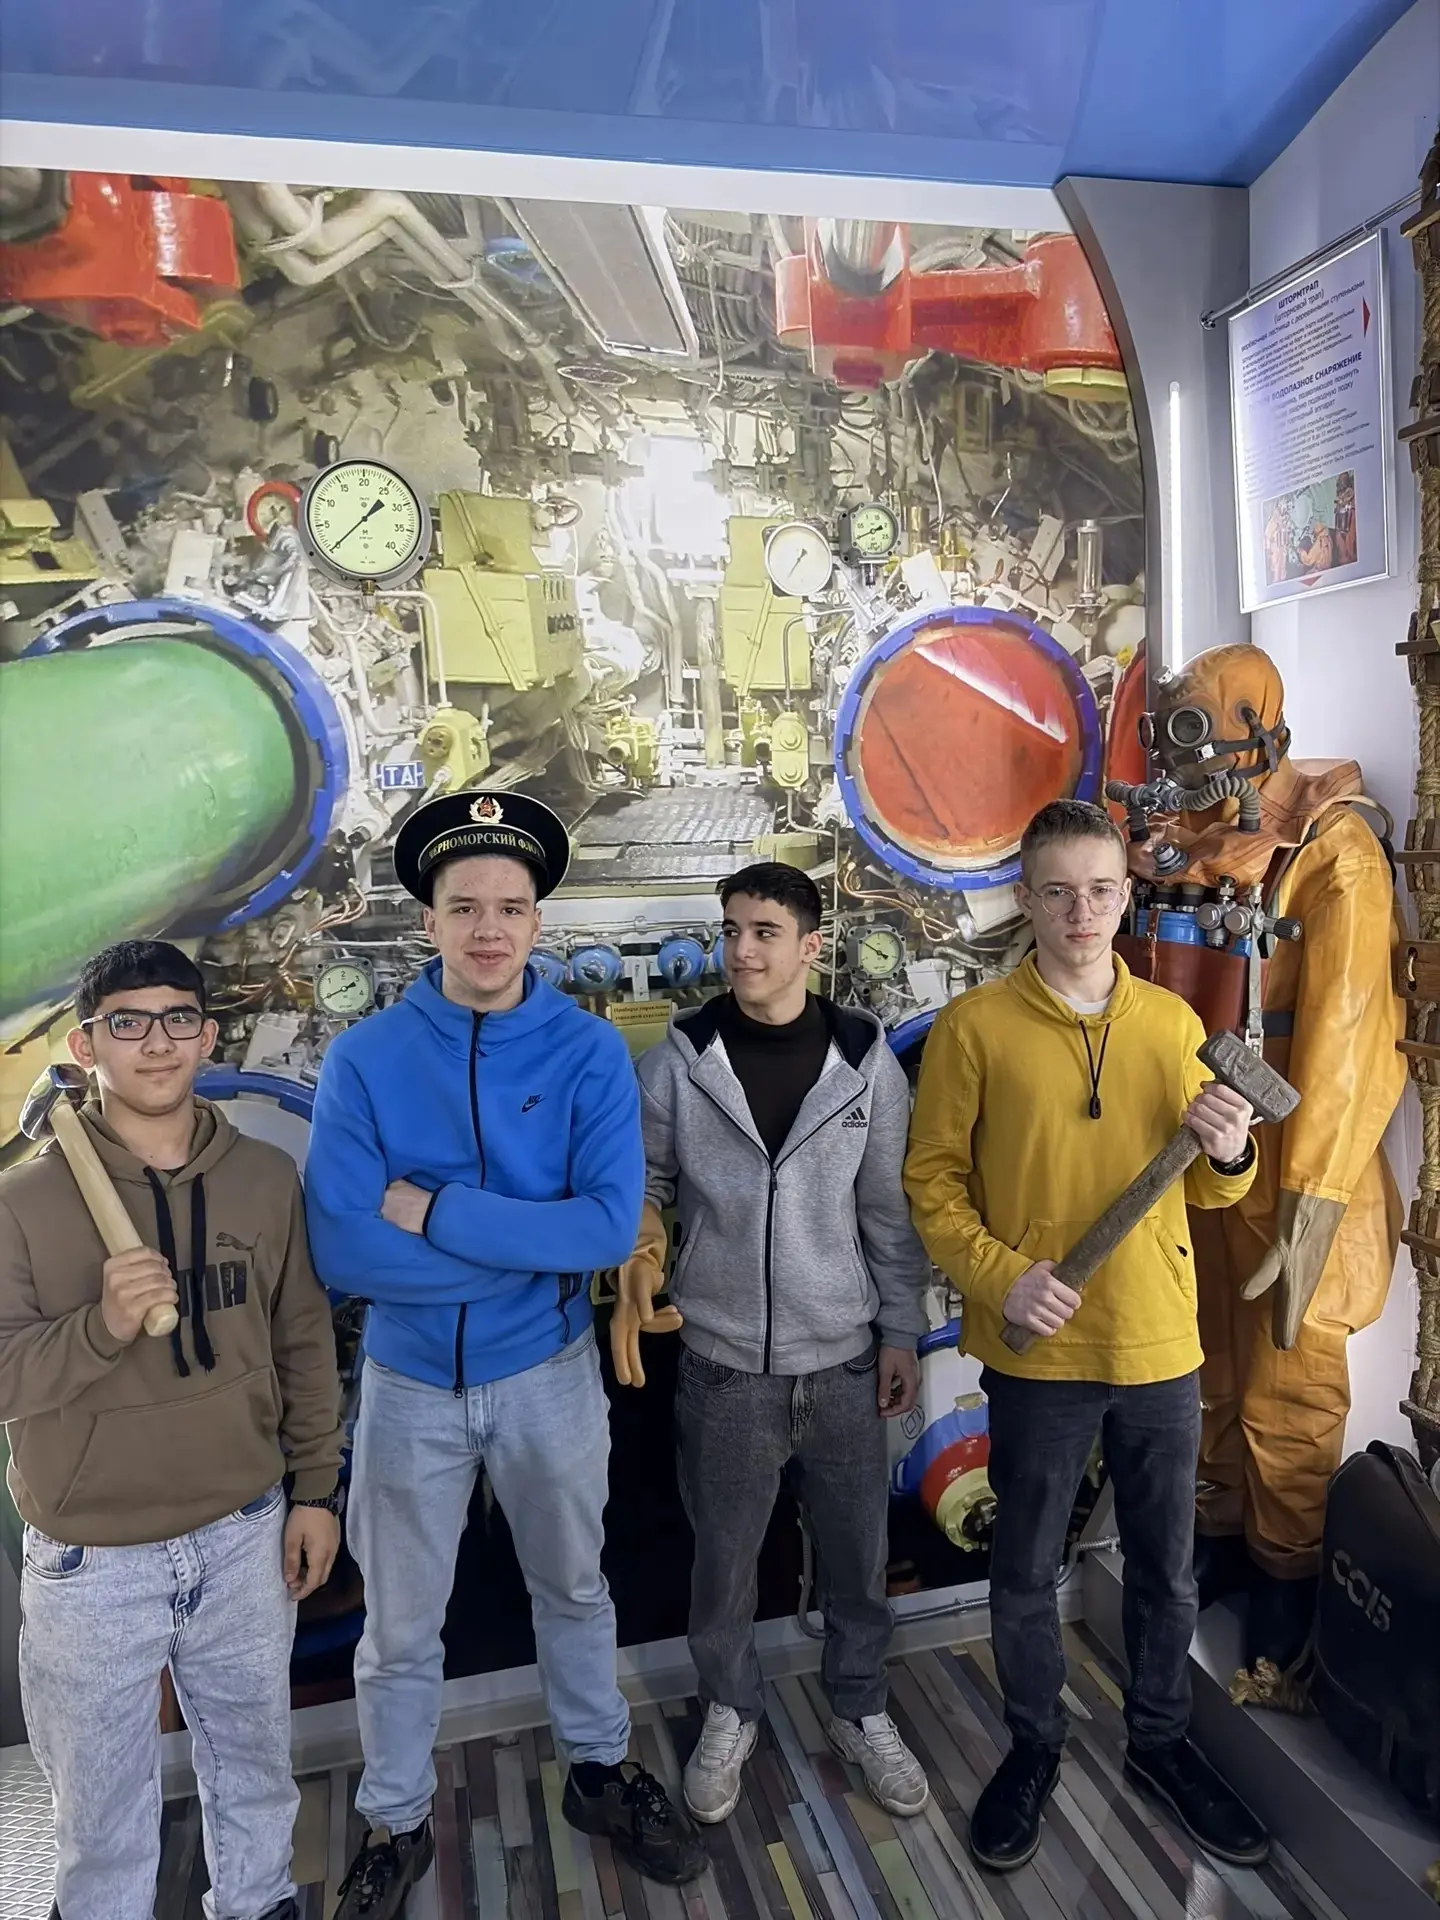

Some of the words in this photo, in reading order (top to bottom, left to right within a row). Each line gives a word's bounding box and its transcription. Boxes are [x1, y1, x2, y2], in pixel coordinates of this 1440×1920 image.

[1278, 279, 1318, 309] ШТОРМТРАП
[1308, 287, 1324, 305] трап)
[1314, 350, 1362, 381] СНАРЯЖЕНИЕ
[359, 478, 370, 487] 20
[340, 484, 349, 492] 15
[379, 487, 389, 495] 25
[327, 499, 335, 507] 10
[392, 503, 402, 512] 30
[324, 520, 330, 528] 5
[394, 523, 405, 532] 35
[385, 541, 396, 550] 40
[841, 1120, 868, 1128] adidas
